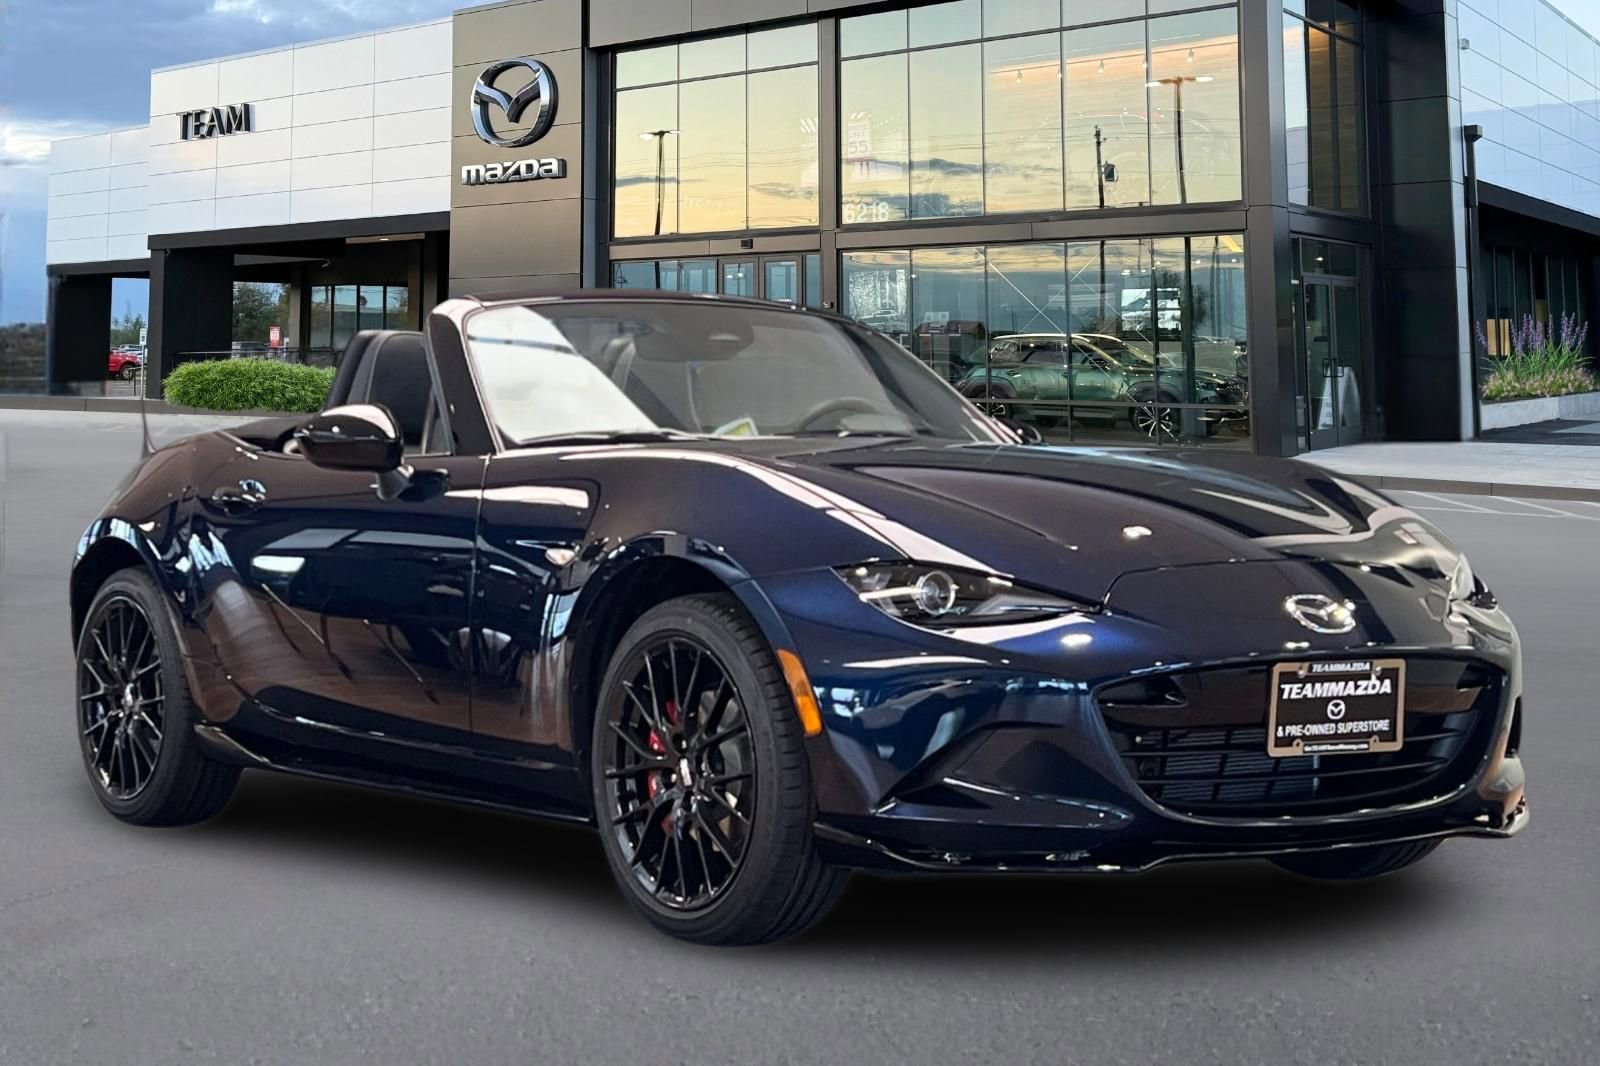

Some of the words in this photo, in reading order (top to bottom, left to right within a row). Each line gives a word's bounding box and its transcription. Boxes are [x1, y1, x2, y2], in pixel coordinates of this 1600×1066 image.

[176, 103, 251, 140] TEAM
[848, 140, 869, 154] 55
[846, 201, 889, 223] 6218
[1281, 679, 1391, 699] TEAMMAZDA
[1277, 725, 1283, 737] &
[1285, 722, 1336, 736] PRE-OWNED
[1337, 719, 1390, 734] SUPERSTORE
